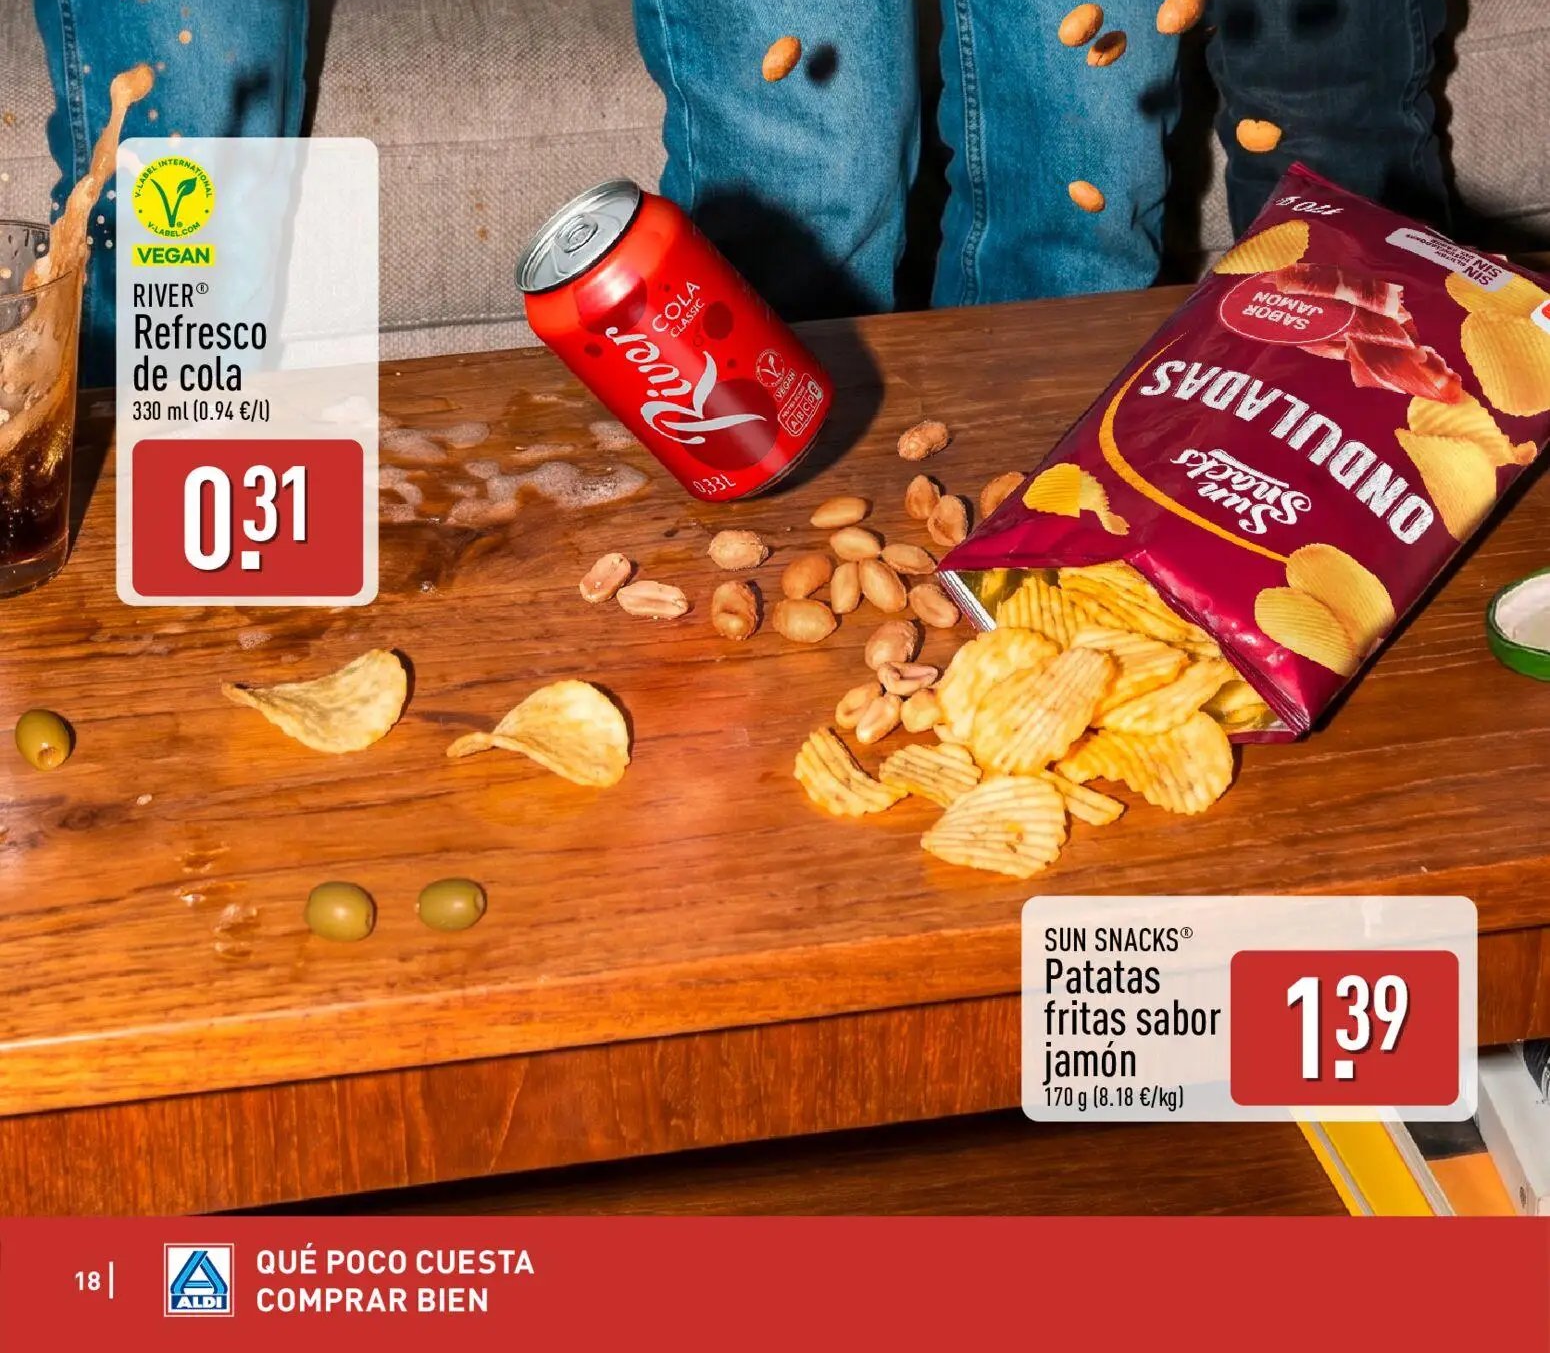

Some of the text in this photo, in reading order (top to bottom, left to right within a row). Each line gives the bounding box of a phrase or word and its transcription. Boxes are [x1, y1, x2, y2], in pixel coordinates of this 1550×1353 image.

[135, 159, 213, 198] V-LABEL INTERNATIONAL
[147, 221, 201, 237] V-LABEL.COM
[137, 247, 210, 264] VEGAN
[1472, 259, 1503, 278] SIN
[1462, 266, 1495, 286] SIN
[651, 280, 701, 333] COLA
[670, 297, 706, 338] CLASSIC
[1242, 304, 1310, 330] SABOR
[134, 314, 267, 350] Refresco
[133, 356, 242, 392] de cola
[605, 326, 768, 445] River
[133, 399, 270, 423] 330 ml (0.94 €/l)
[1141, 360, 1435, 545] ONDULADAS
[1170, 449, 1312, 525] Snacks
[184, 464, 308, 571] 0.31
[1197, 481, 1276, 535] Sun
[1045, 927, 1086, 951] SUN
[1046, 958, 1160, 994] Patatas
[1044, 999, 1221, 1035] fritas sabor
[1286, 974, 1410, 1080] 1.39
[1043, 1041, 1136, 1086] jamón
[1045, 1085, 1183, 1111] 170 g (8.18 €/kg)
